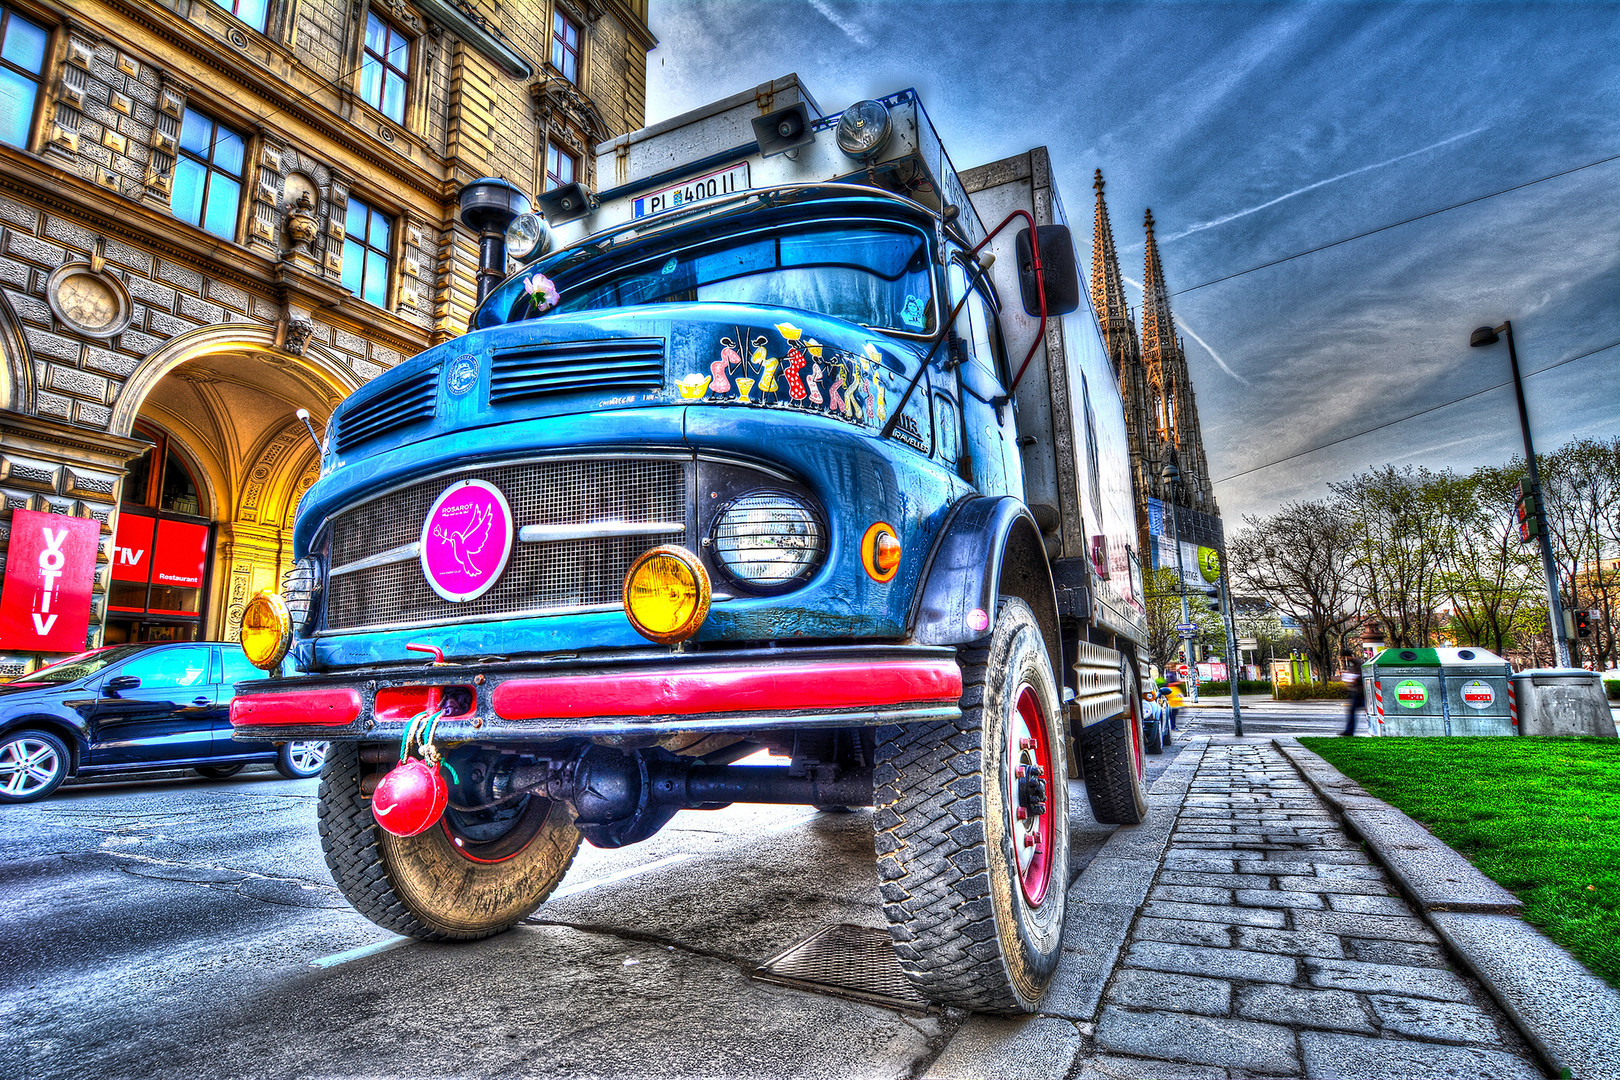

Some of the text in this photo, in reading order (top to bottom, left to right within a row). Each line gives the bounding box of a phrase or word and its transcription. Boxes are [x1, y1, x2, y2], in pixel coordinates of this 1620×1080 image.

[442, 503, 474, 513] ROSAROT
[32, 528, 69, 636] VOTIV
[159, 573, 198, 583] Restaurant
